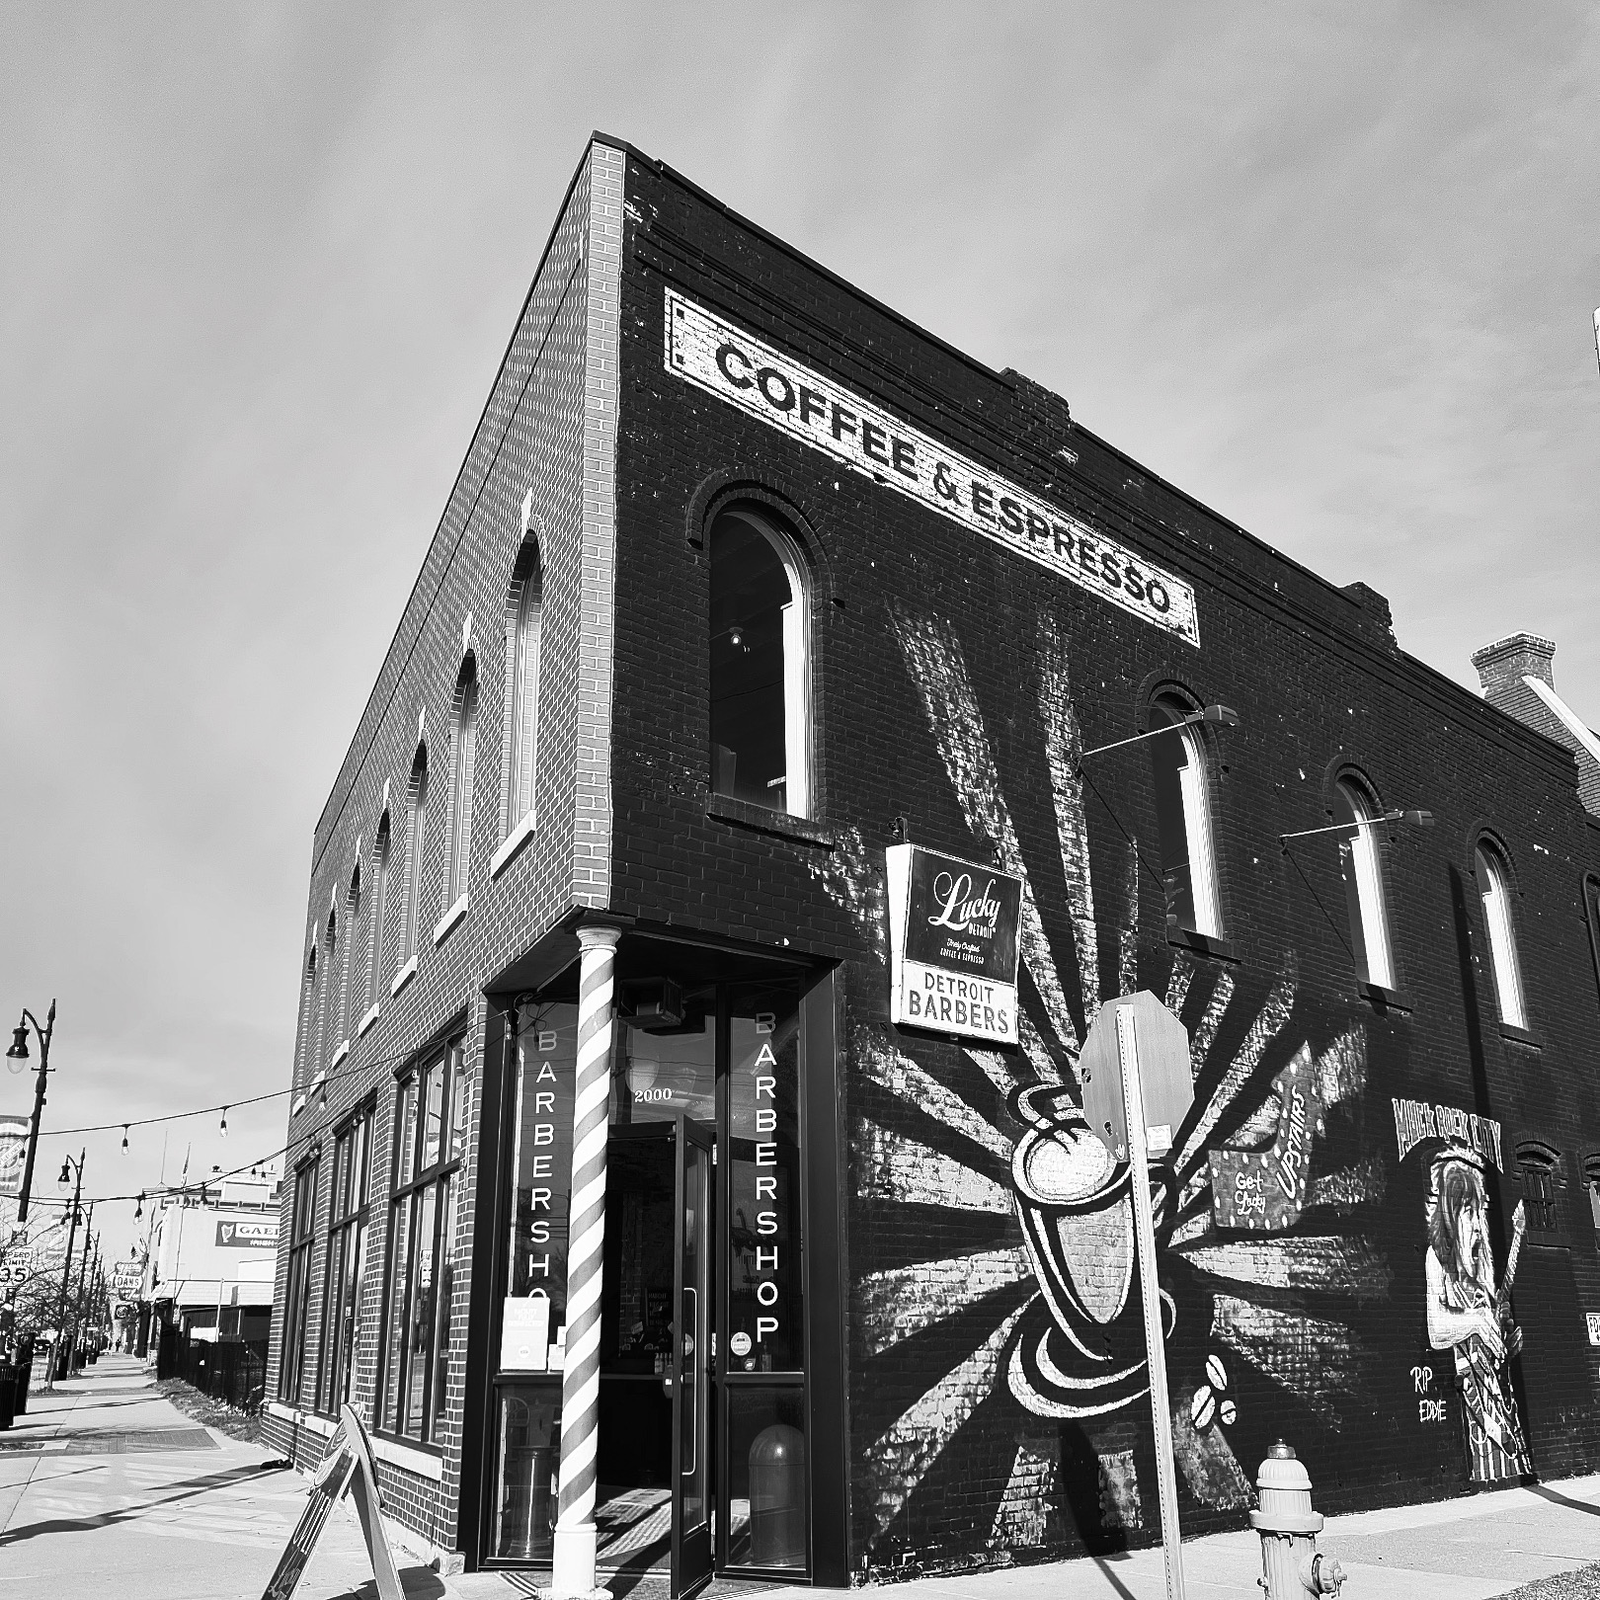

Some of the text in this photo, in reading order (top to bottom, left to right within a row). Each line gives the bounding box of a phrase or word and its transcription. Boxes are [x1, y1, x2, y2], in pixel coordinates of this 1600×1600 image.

[715, 343, 1171, 613] COFFEE & ESPRESSO
[927, 871, 1001, 931] Lucky
[924, 971, 994, 1004] DETROIT
[908, 989, 1009, 1034] BARBERS
[634, 1087, 673, 1103] 2000
[1276, 1084, 1306, 1200] UPSTAIRS
[1469, 1113, 1504, 1175] CITY
[530, 1030, 558, 1298] BARBERSH
[755, 1011, 779, 1343] BARBERSHOP
[1235, 1169, 1264, 1193] Get
[0, 1267, 27, 1283] 35
[1588, 1316, 1600, 1333] FD
[1410, 1366, 1433, 1395] RIP
[1418, 1399, 1447, 1422] EDDIE
